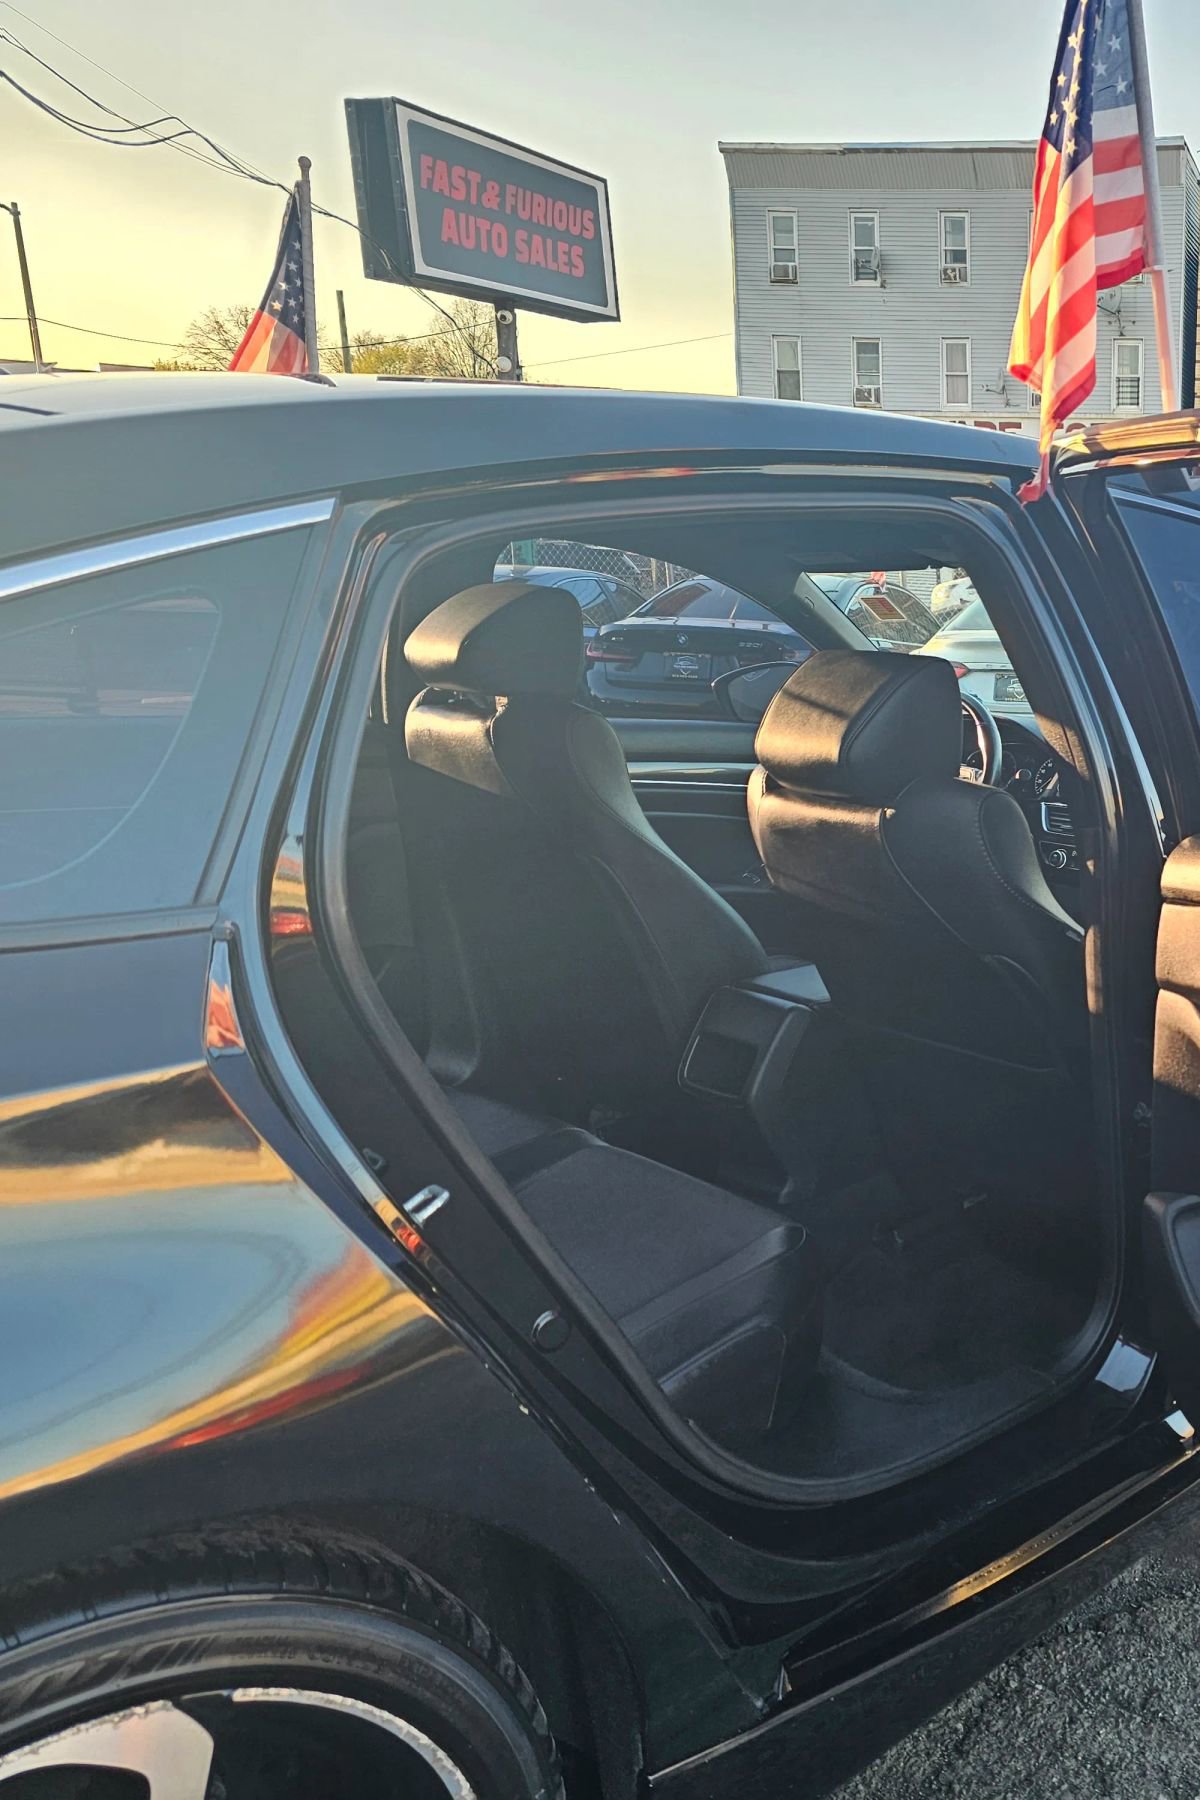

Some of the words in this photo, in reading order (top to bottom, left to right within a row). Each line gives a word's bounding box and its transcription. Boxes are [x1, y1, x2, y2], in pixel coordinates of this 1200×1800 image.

[440, 207, 508, 258] AUTO
[514, 228, 585, 279] SALES
[504, 184, 596, 240] FURIOUS
